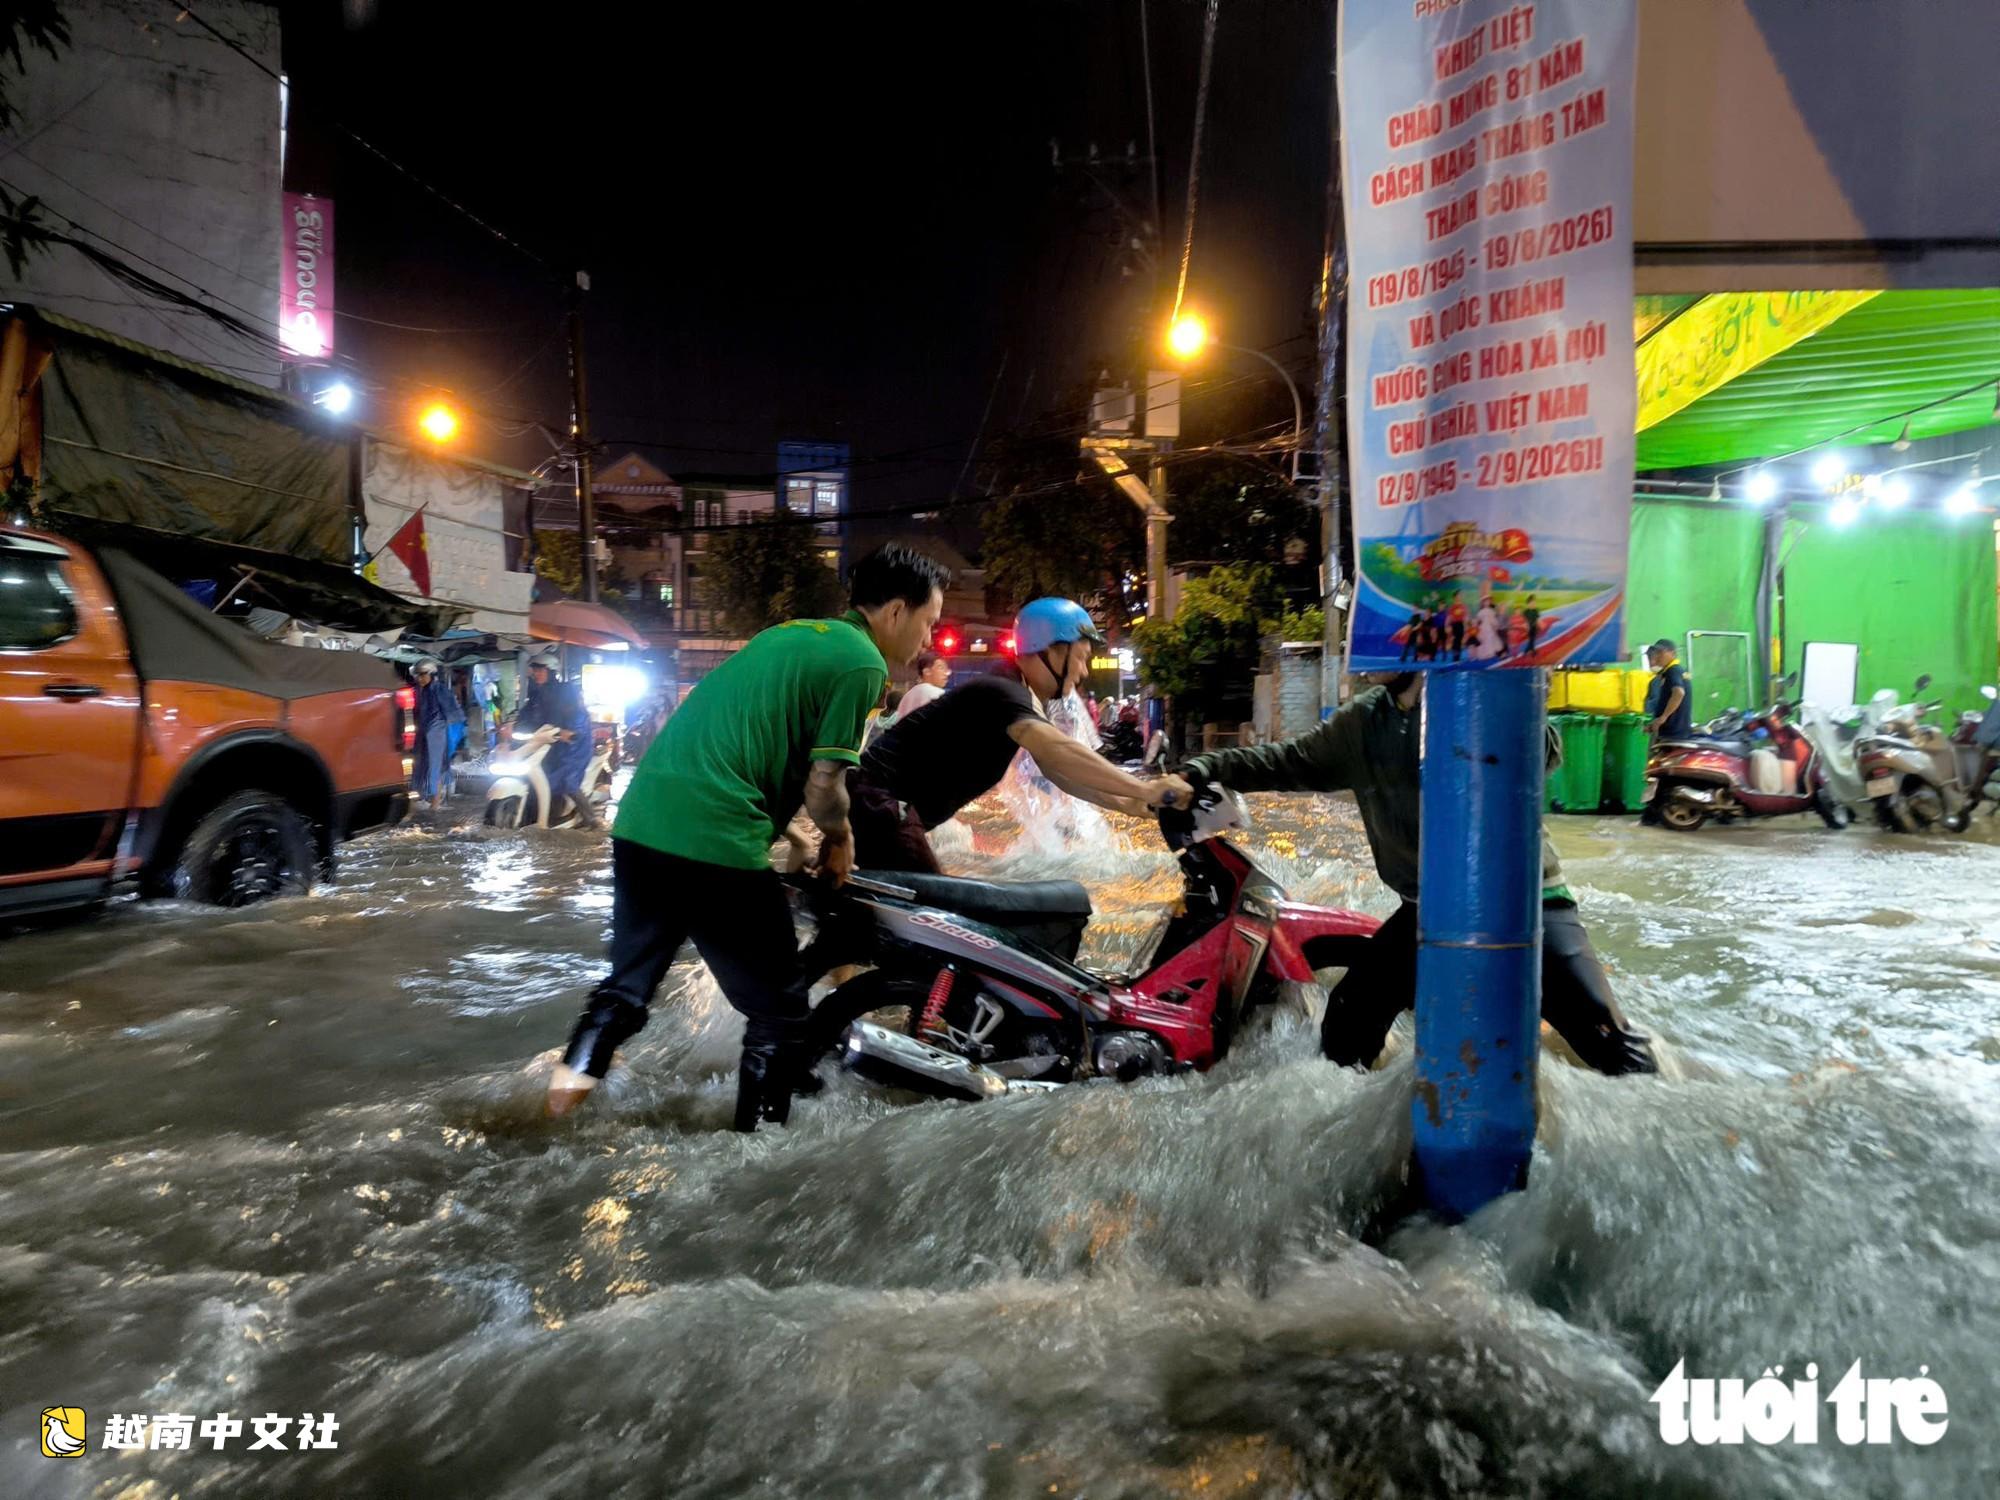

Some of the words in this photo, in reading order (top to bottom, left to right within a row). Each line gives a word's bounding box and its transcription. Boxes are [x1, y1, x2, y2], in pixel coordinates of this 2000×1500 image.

[1490, 7, 1534, 50] LIỆT
[1388, 103, 1442, 148] CHÀO
[1506, 64, 1531, 101] 81
[1372, 161, 1424, 206] CÁCH
[1431, 138, 1476, 188] MẠNG
[1483, 111, 1554, 161] THÁNG
[1561, 88, 1605, 138] TÁM
[1487, 170, 1548, 216] CÔNG
[1410, 310, 1434, 347] VÀ
[1489, 276, 1564, 324] KHÁNH
[1375, 366, 1427, 406] NƯỚC
[1530, 329, 1557, 370] XÃ
[1566, 320, 1605, 365] HỘI
[1389, 413, 1425, 454] CHỦ
[1486, 391, 1531, 433] VIỆT
[1538, 384, 1588, 422] NAM
